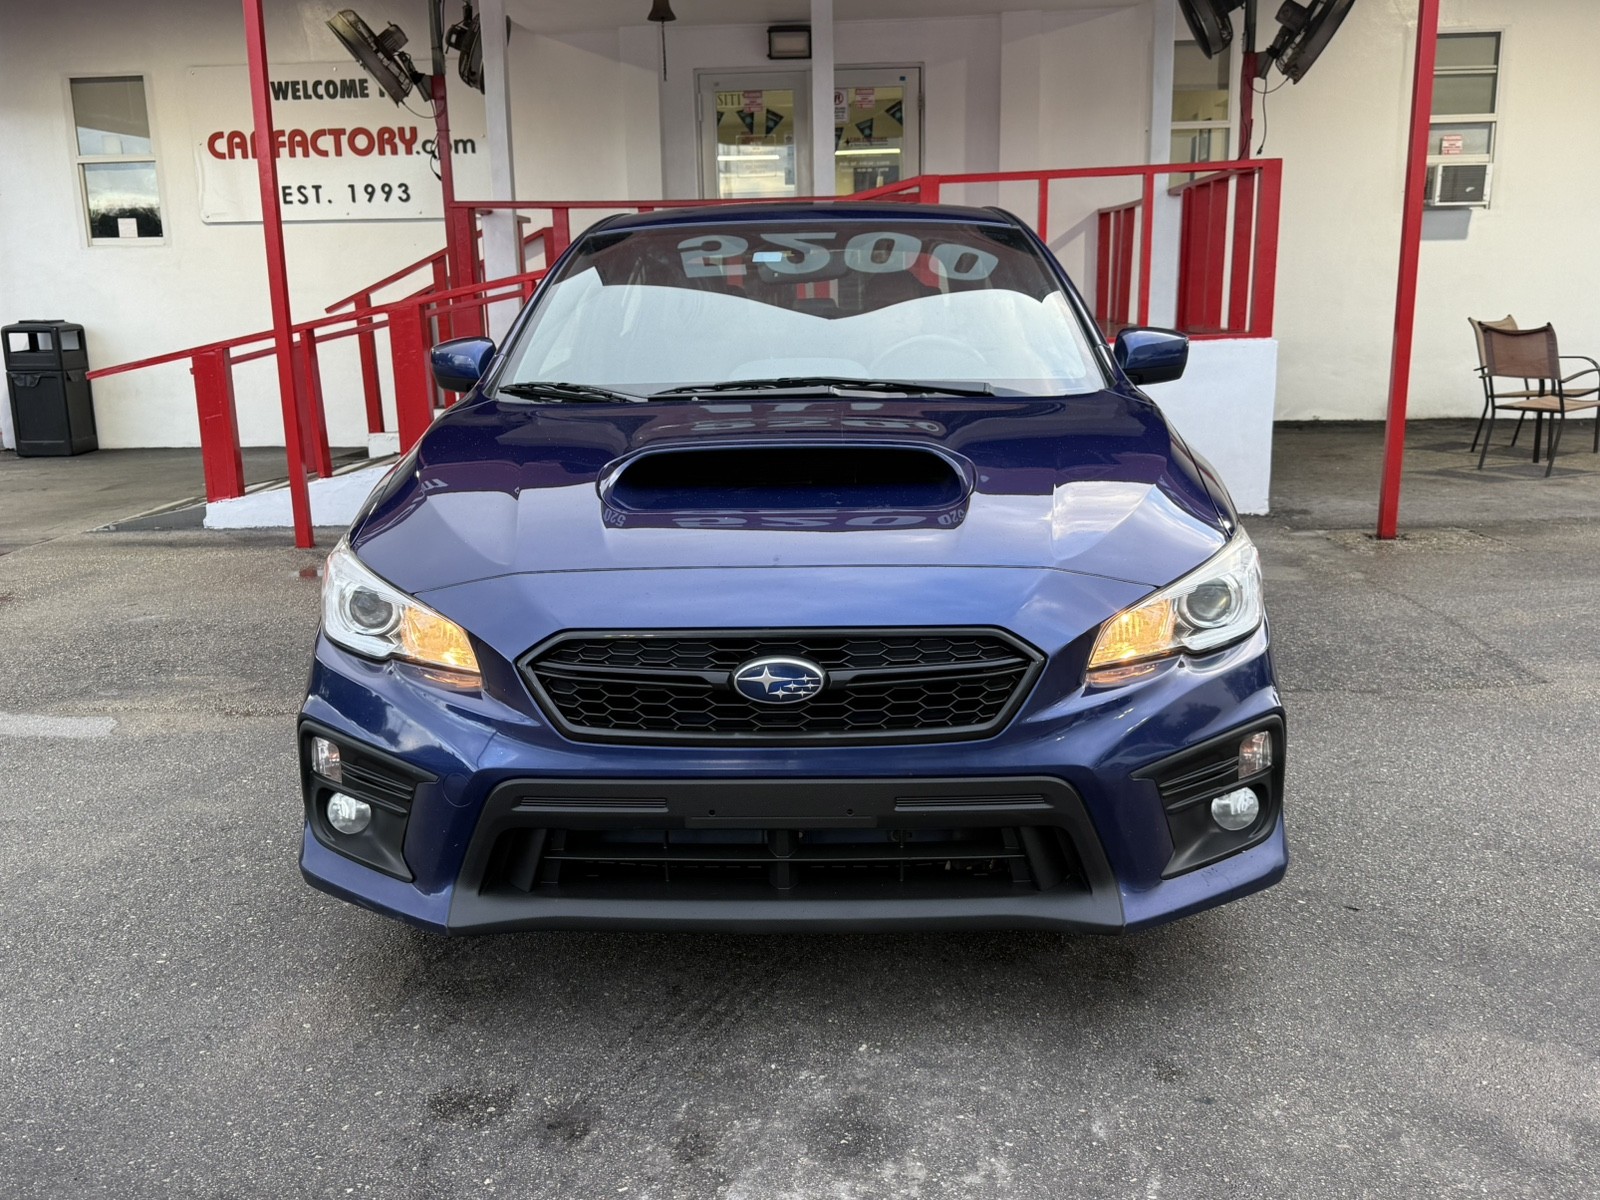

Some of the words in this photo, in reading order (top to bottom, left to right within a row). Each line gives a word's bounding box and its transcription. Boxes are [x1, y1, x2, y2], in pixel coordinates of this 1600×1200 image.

[270, 78, 369, 100] WELCOME
[282, 185, 333, 204] EST.
[347, 183, 412, 203] 1993
